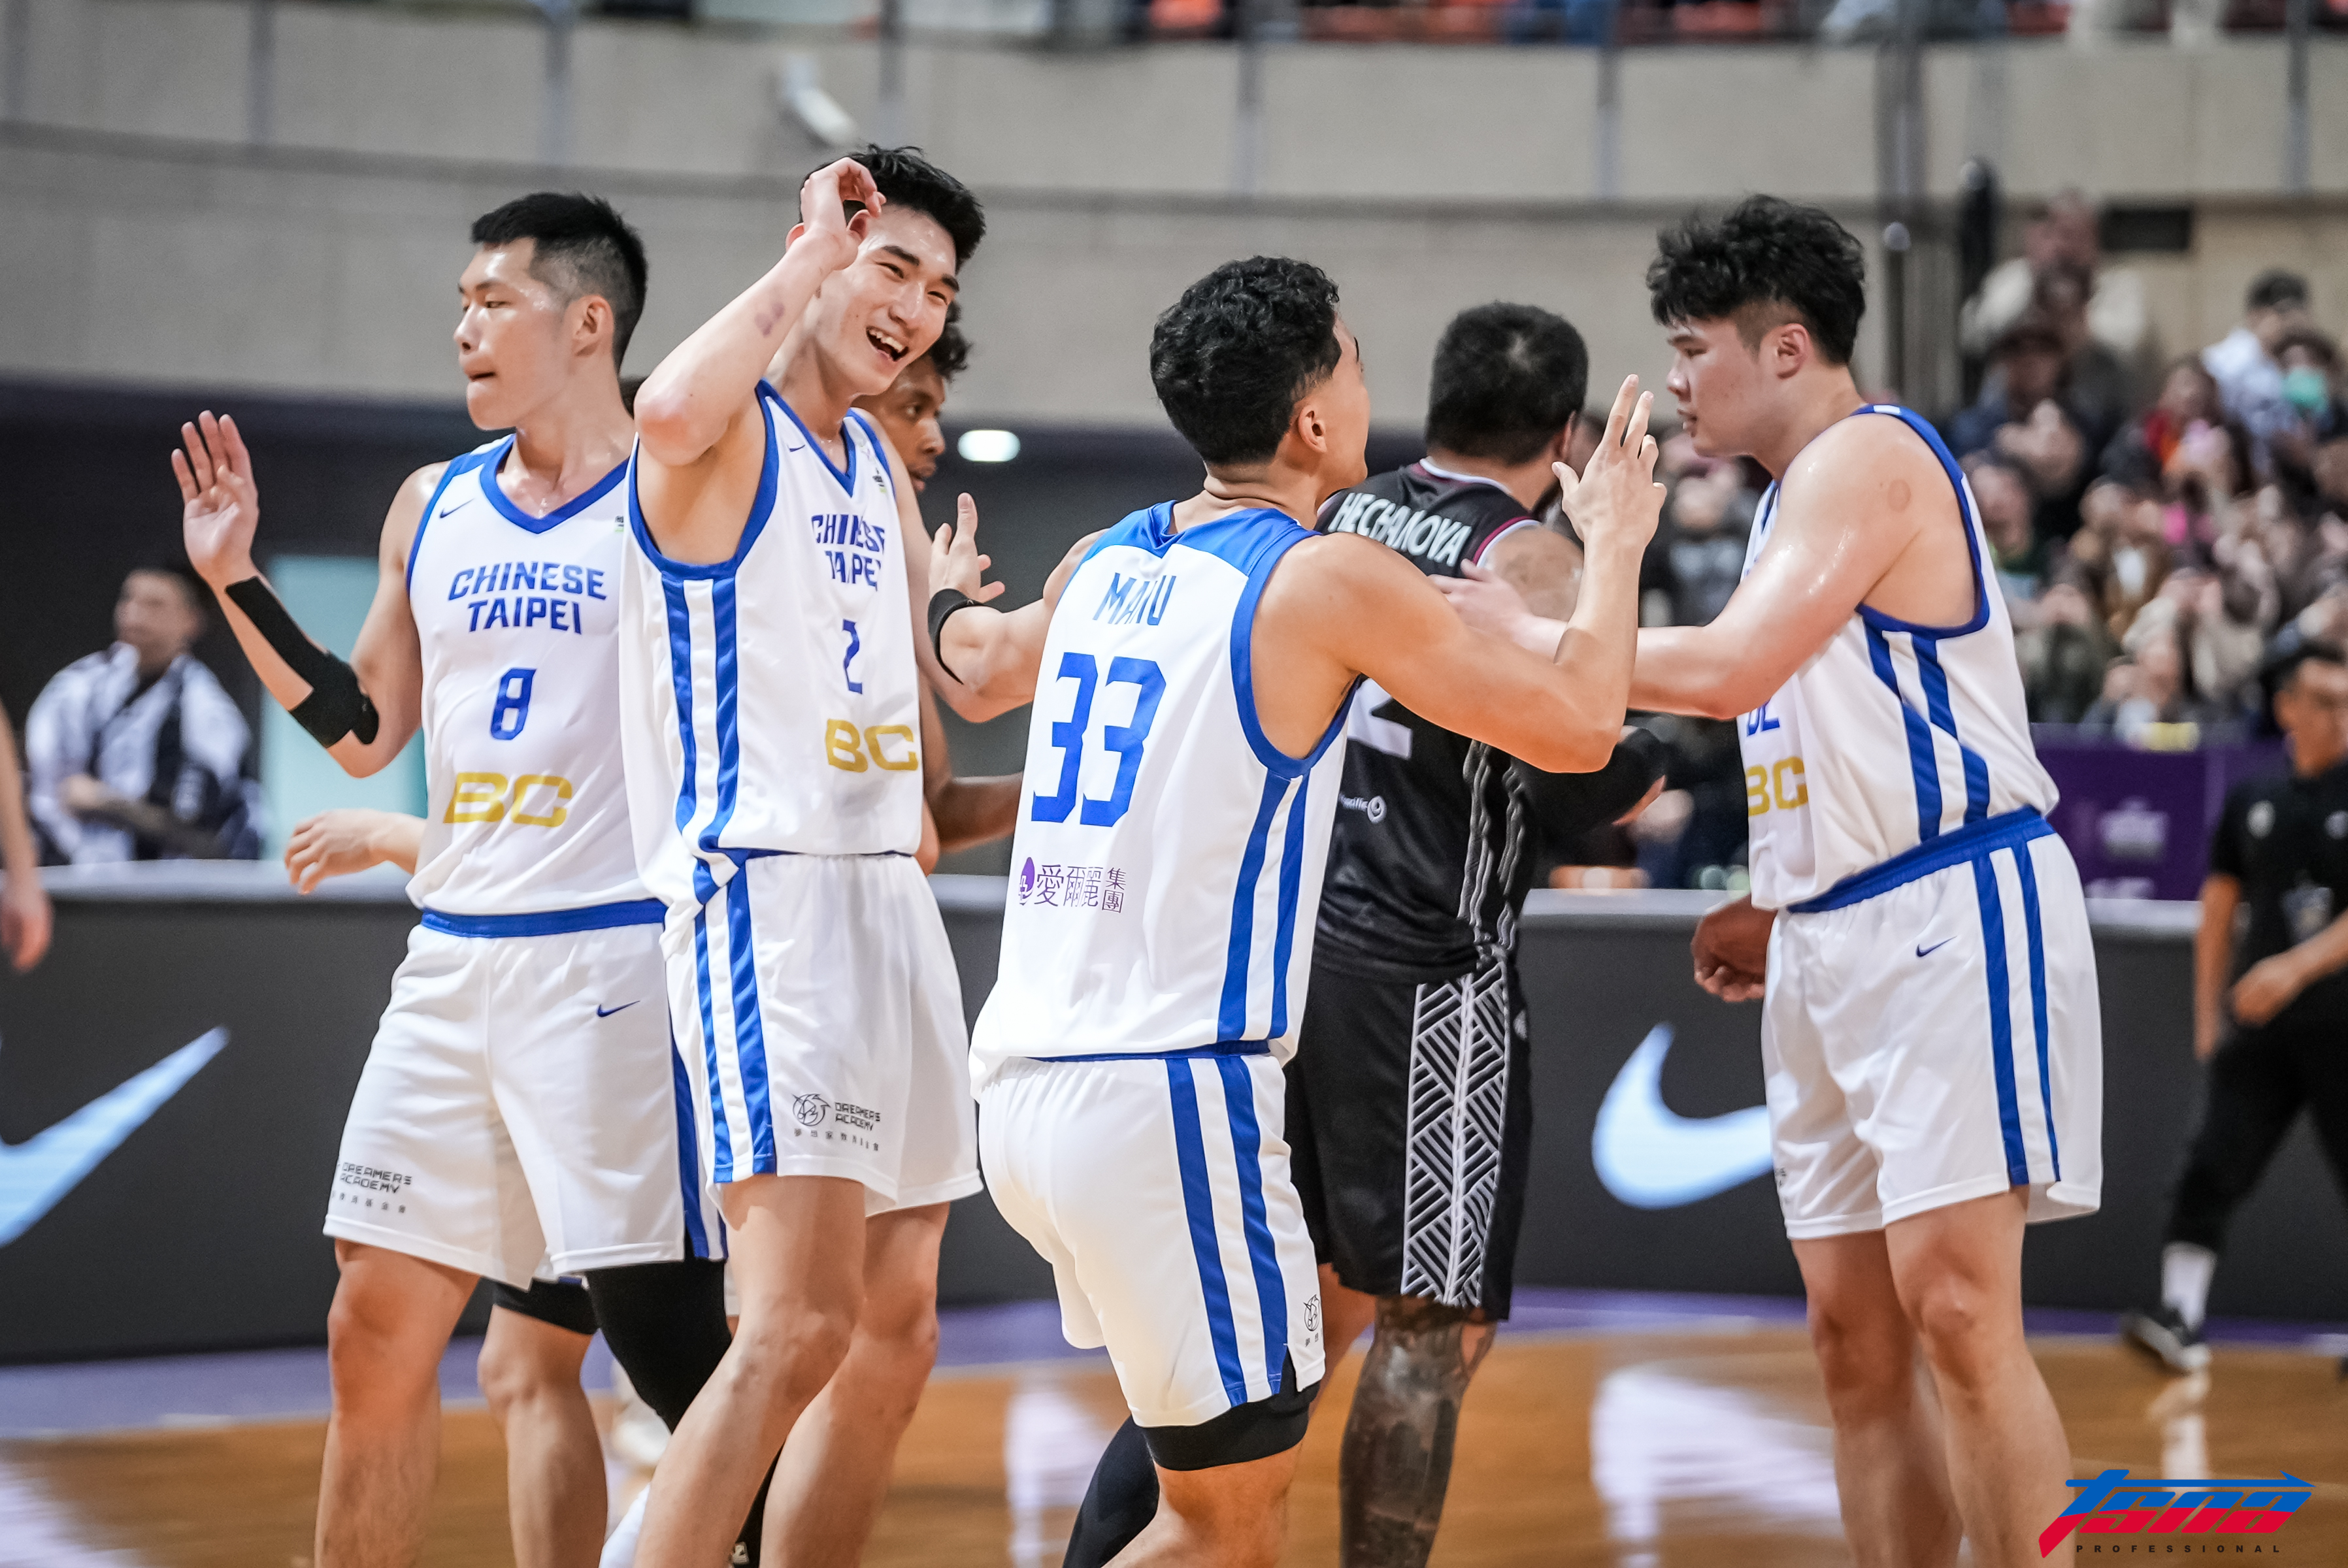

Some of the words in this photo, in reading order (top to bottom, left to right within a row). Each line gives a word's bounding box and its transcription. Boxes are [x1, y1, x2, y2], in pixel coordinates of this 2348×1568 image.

[1327, 492, 1472, 567] HECHANOVA
[448, 561, 607, 600] CHINESE
[824, 551, 882, 592] TAPE
[468, 597, 582, 634] TAIPEI
[842, 619, 863, 694] 2
[490, 668, 537, 740] 8
[825, 719, 919, 772] BC
[1031, 651, 1166, 827] 33
[442, 772, 573, 828] BC
[1745, 756, 1808, 817] BC
